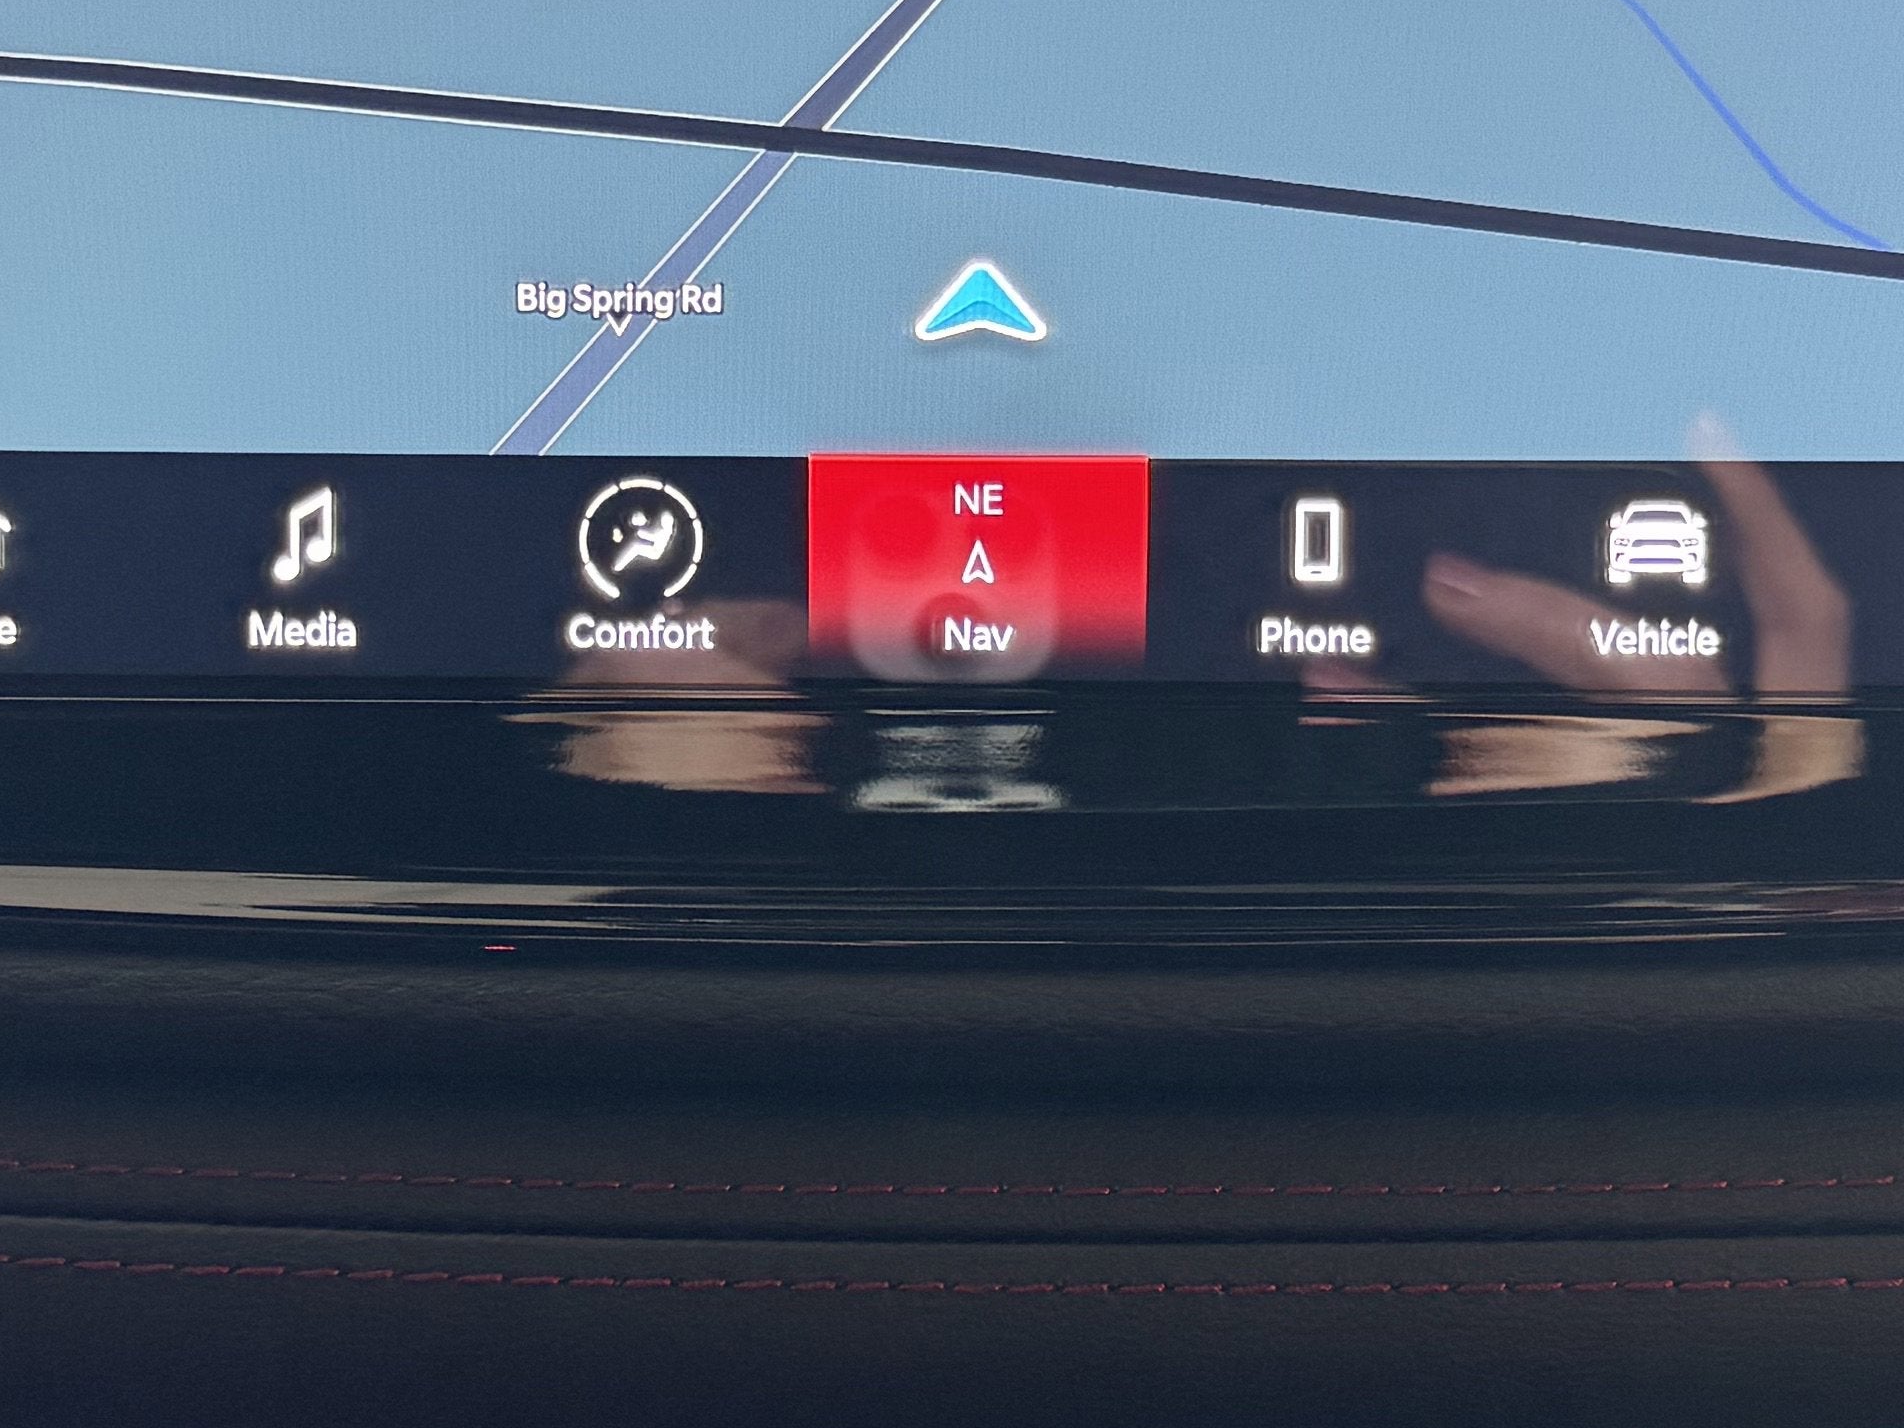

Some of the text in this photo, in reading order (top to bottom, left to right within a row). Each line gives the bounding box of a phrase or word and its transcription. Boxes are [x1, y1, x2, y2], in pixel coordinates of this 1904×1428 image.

[514, 281, 725, 321] Big Spring Rd
[953, 483, 1005, 517] NE
[247, 612, 358, 652] Media
[566, 614, 717, 654] Comfort
[942, 618, 1014, 653] Nav
[1258, 618, 1373, 656] Phone
[1589, 618, 1722, 659] Vehicle
